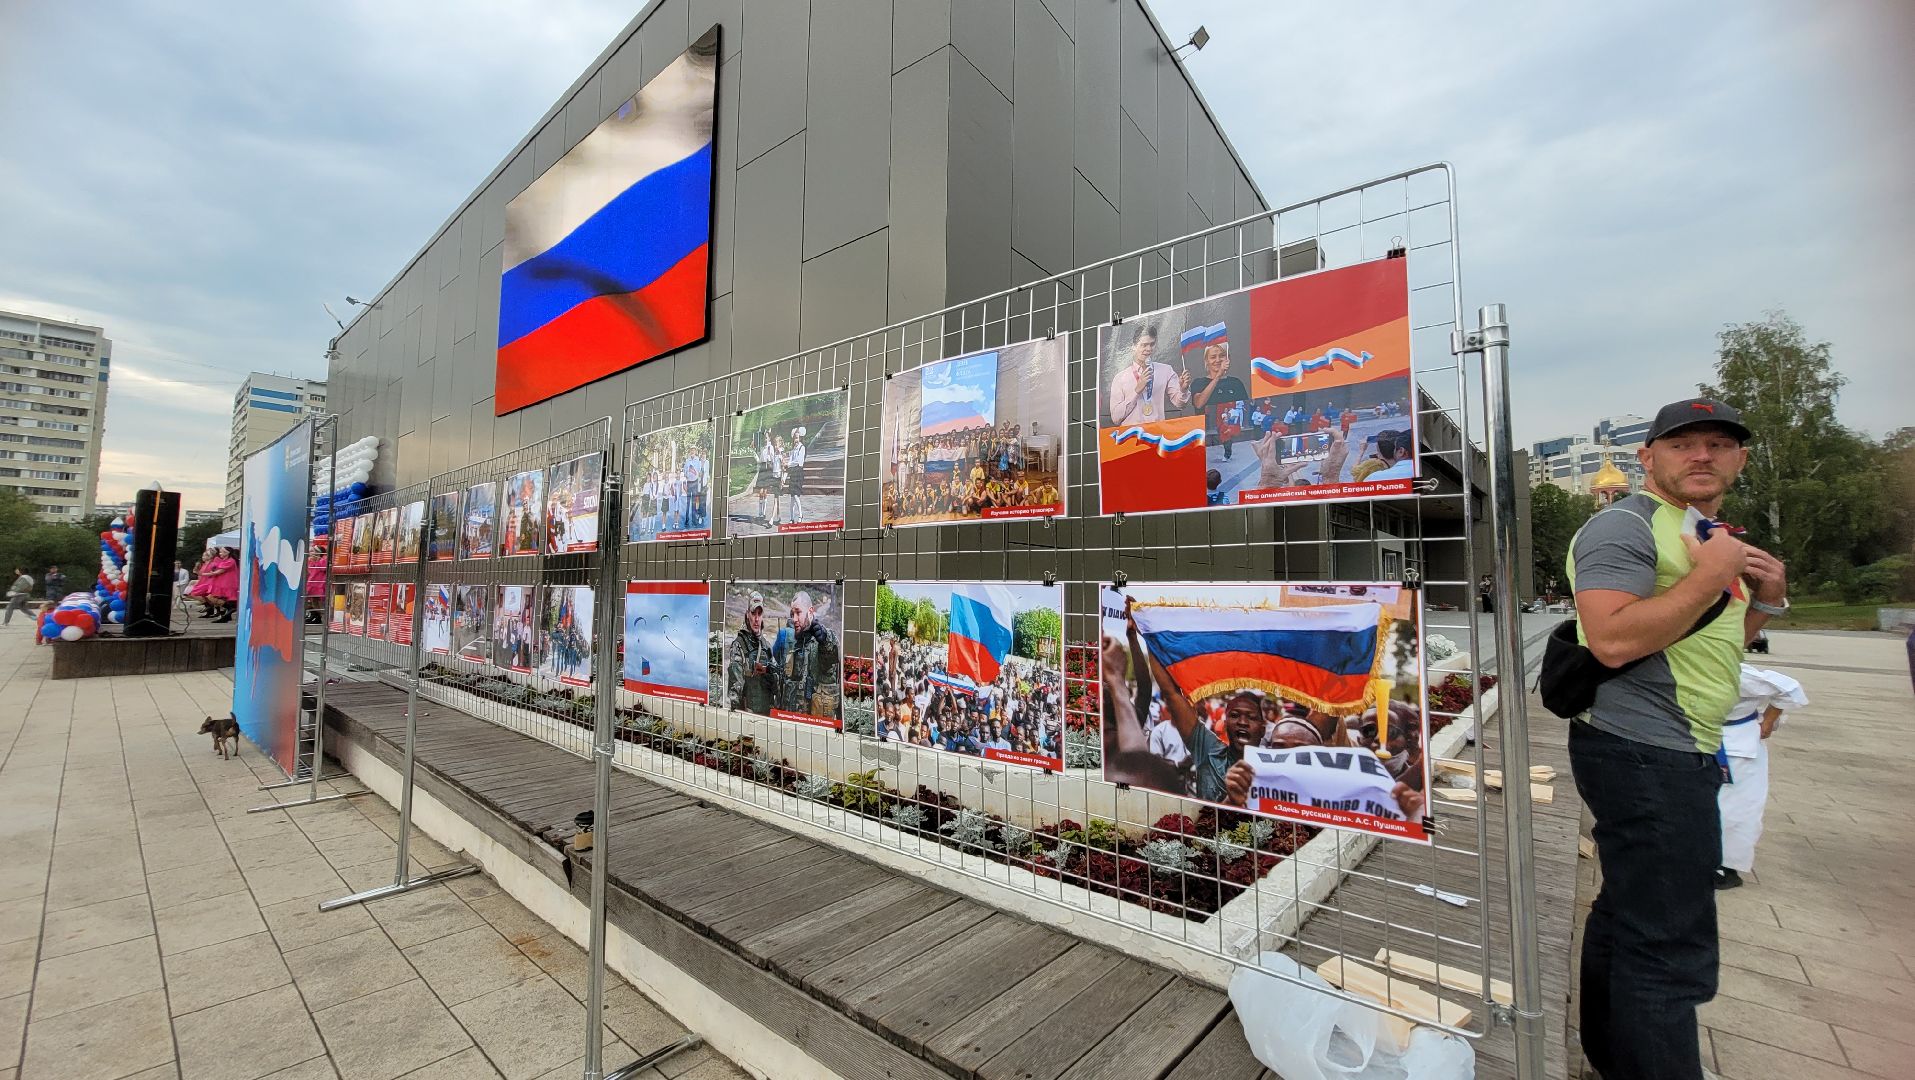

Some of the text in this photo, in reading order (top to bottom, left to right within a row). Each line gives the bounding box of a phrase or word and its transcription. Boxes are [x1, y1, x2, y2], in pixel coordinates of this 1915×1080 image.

[1308, 487, 1341, 496] чемпион
[1342, 484, 1375, 493] Евгений
[1376, 483, 1407, 491] Рылов.
[1257, 751, 1389, 779] VIVE
[1273, 804, 1408, 833] «Здесь русский дух». А.С. Пушкин.
